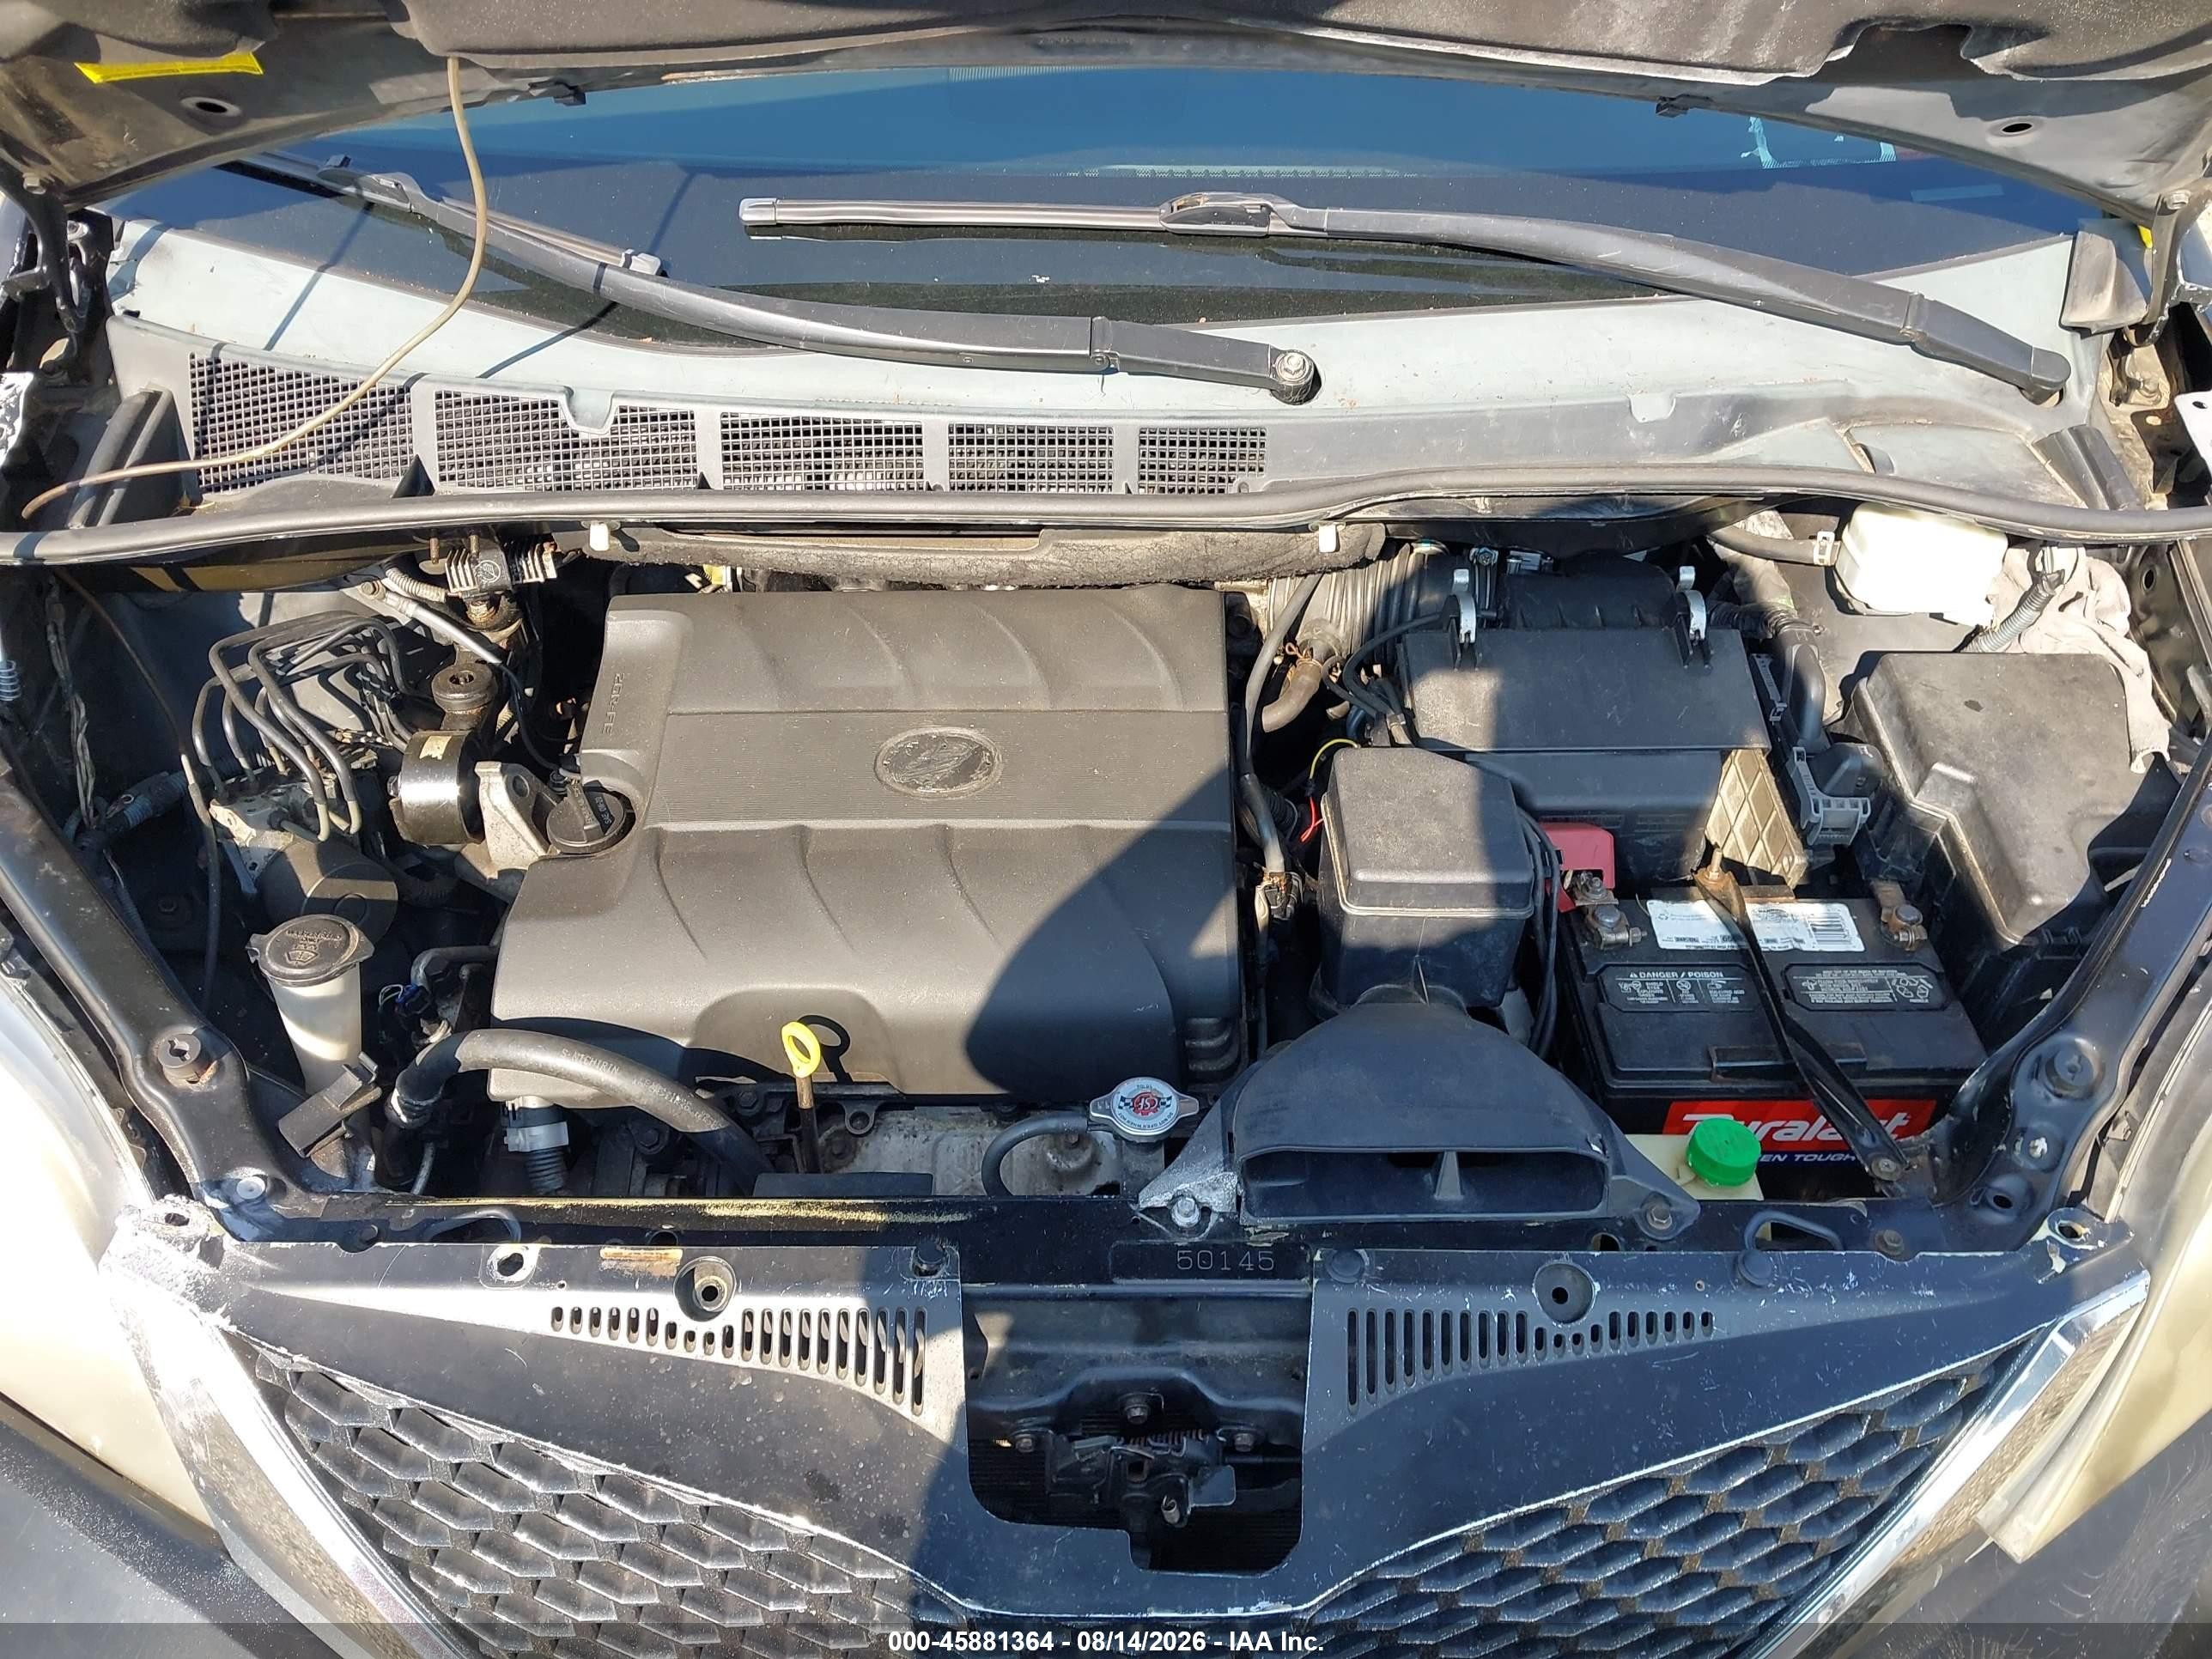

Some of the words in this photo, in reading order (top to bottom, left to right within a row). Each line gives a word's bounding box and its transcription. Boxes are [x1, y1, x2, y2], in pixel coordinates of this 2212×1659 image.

[1138, 1097, 1158, 1110] CSF
[1682, 1112, 1911, 1142] uralat
[1176, 1249, 1274, 1271] 50145
